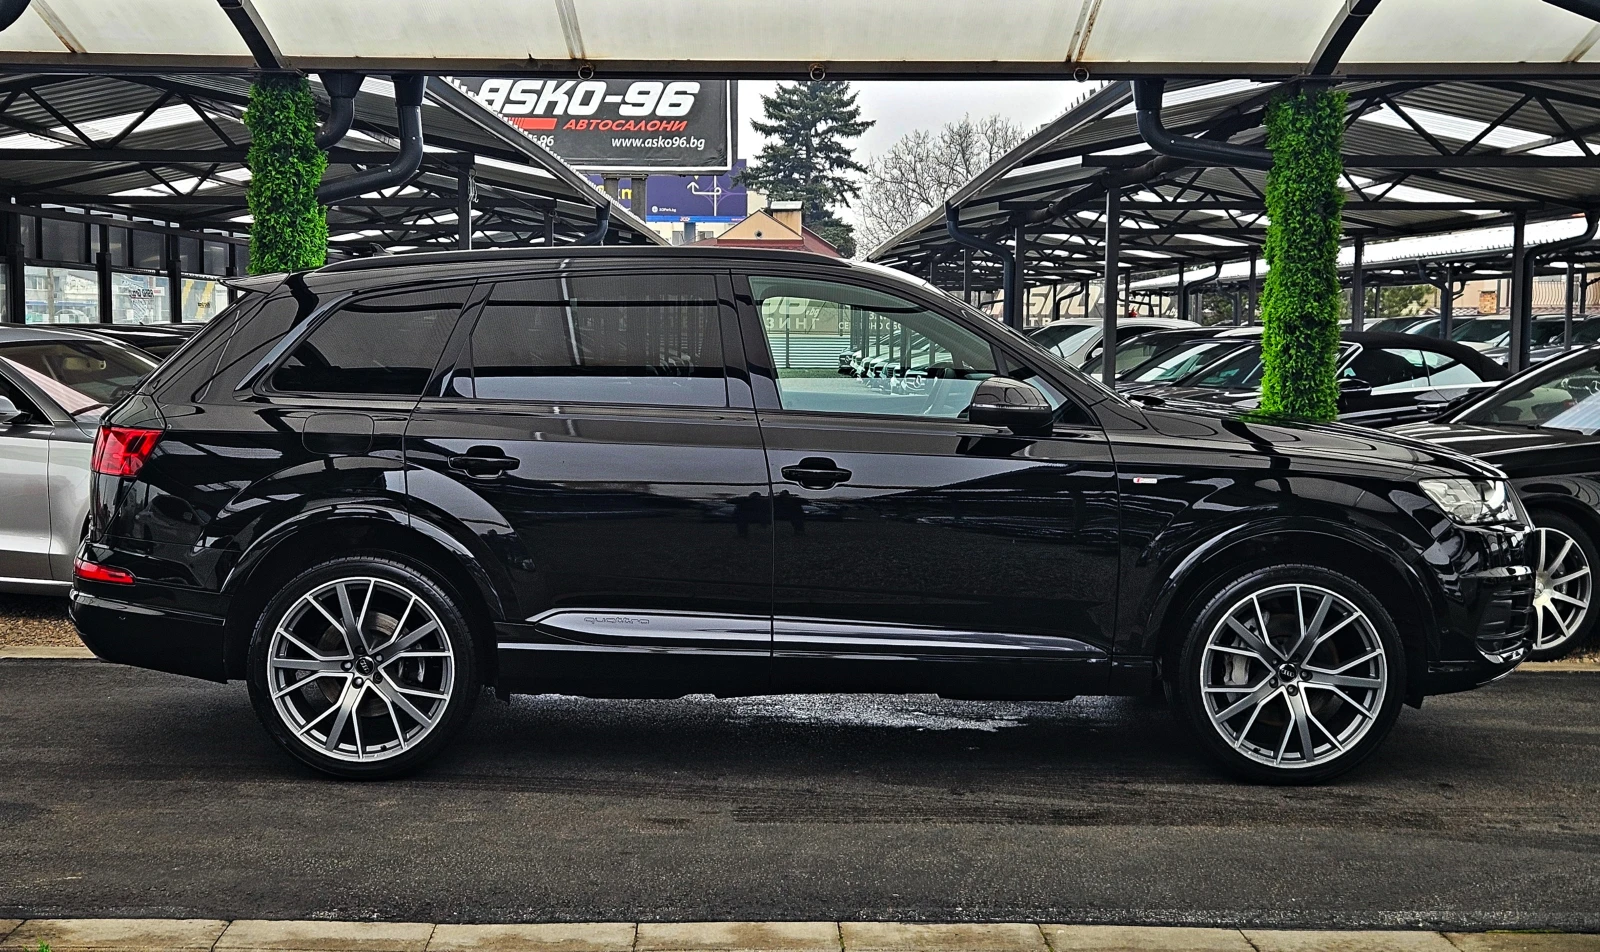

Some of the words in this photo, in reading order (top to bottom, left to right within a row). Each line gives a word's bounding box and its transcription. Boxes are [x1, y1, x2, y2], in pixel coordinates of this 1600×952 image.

[478, 79, 700, 117] ASKO-96
[563, 119, 687, 132] АВТОСАЛОНИ
[611, 135, 705, 150] www.asko96.bg
[583, 616, 650, 625] quattro
